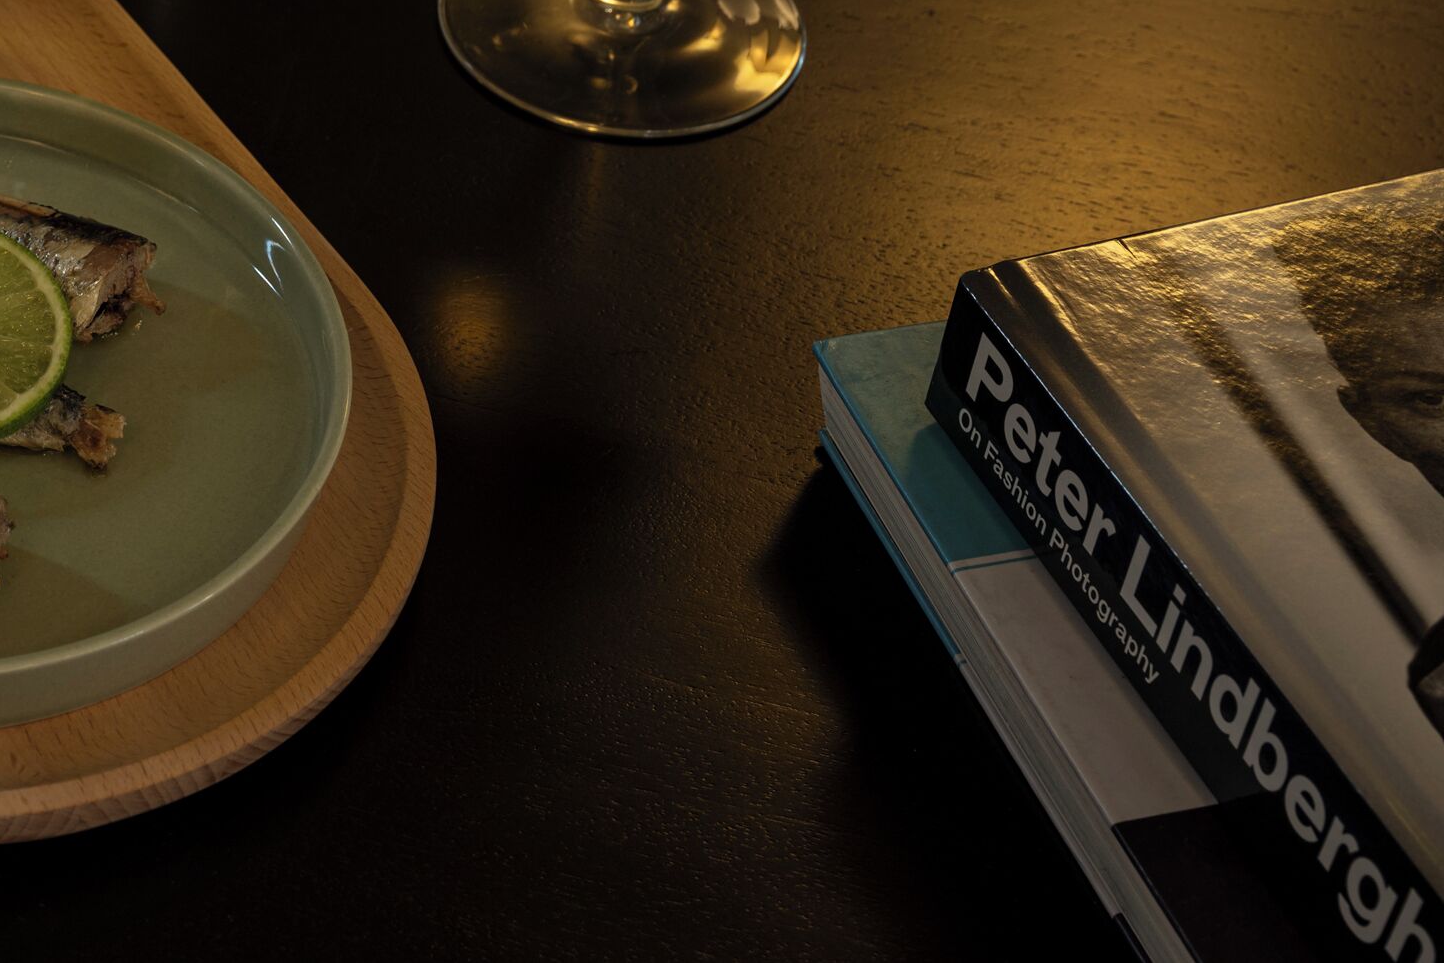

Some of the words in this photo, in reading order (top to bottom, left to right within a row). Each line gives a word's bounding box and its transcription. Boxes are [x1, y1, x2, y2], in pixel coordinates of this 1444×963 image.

[958, 407, 982, 449] On
[983, 442, 1048, 536] Fashion
[1049, 527, 1160, 686] Photography
[965, 331, 1117, 557] Peter
[1119, 534, 1437, 963] Lindbergh
